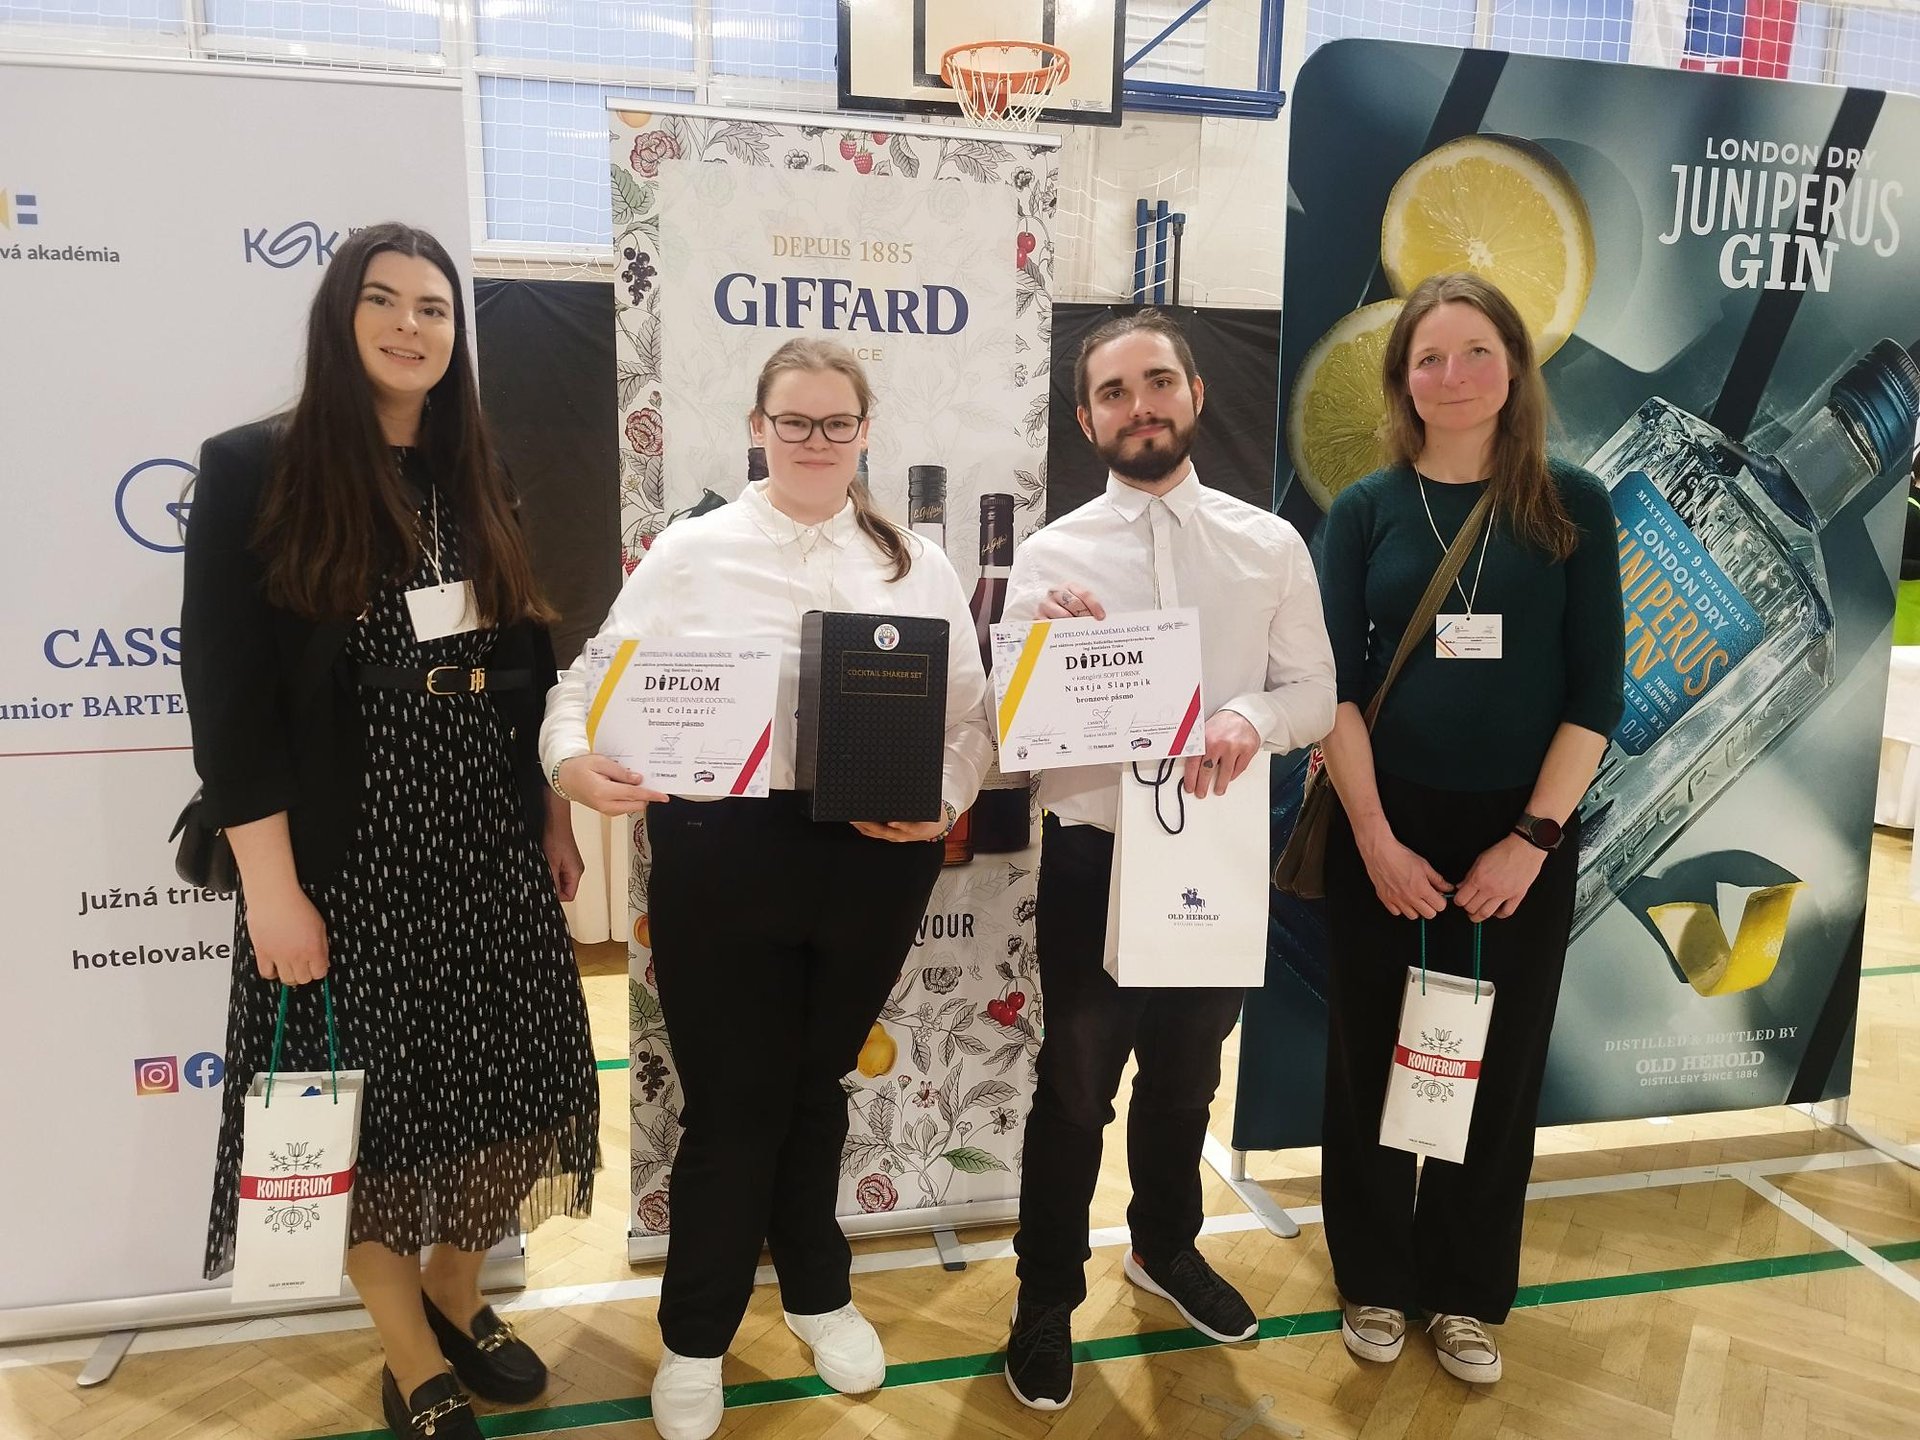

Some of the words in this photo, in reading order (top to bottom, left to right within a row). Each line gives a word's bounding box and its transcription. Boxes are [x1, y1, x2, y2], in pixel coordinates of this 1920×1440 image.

[1705, 137, 1820, 167] LONDON
[1826, 146, 1878, 171] DRY
[1658, 164, 1904, 258] JUNIPERUS
[27, 244, 120, 263] akadémia
[772, 235, 852, 258] DEPUIS
[859, 240, 914, 264] 1885
[1718, 232, 1840, 293] GIN
[714, 272, 969, 336] GIFFARD
[1636, 490, 1678, 541] MIXTURE
[1677, 540, 1692, 556] OF
[1691, 555, 1703, 567] 9
[1699, 568, 1752, 632] BOTANICALS
[1634, 518, 1700, 598] LONDON
[1694, 593, 1730, 632] DRY
[1615, 518, 1729, 696] NIPERUS
[1126, 624, 1151, 633] KOŠICE
[847, 669, 882, 678] COCKTAIL
[882, 670, 909, 679] SHAKER
[910, 671, 923, 679] SET
[1065, 683, 1102, 692] Nastja
[1076, 694, 1109, 703] bronzové
[1110, 694, 1134, 702] pásmo
[1643, 682, 1671, 714] SLOVAKIA
[81, 693, 191, 718] BARTE
[642, 706, 662, 714] Ana
[1622, 718, 1648, 750] 0,7L
[1650, 714, 1665, 730] BY
[78, 885, 158, 916] Južná
[72, 941, 231, 970] hotelovake
[1605, 1035, 1688, 1052] DISTILLED
[1706, 1028, 1775, 1045] BOTTLED
[1778, 1026, 1798, 1039] BY
[1407, 1052, 1467, 1077] KONIFERUM
[1635, 1057, 1676, 1075] OLD
[1681, 1050, 1765, 1071] HEROLD
[1640, 1074, 1700, 1087] DISTILLERY
[1702, 1071, 1732, 1081] SINCE
[1736, 1069, 1758, 1079] 1886
[256, 1176, 333, 1198] KONIFERUM
